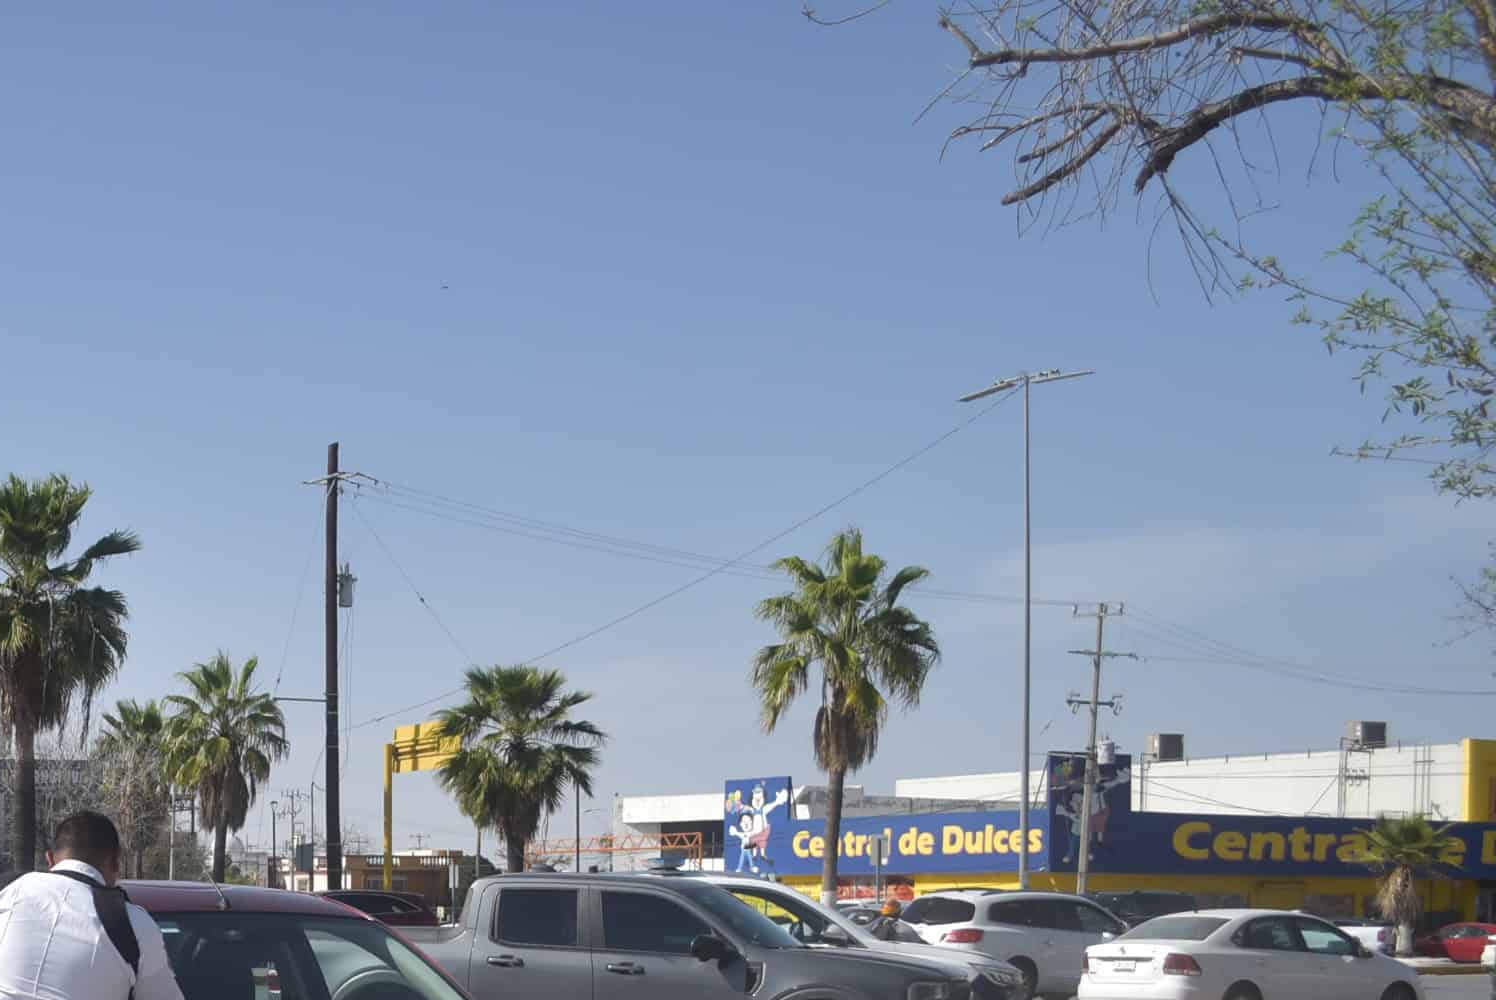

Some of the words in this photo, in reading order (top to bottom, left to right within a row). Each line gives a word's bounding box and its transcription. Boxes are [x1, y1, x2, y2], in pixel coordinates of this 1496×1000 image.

[793, 826, 892, 858] Cetrl
[898, 827, 935, 855] de
[942, 824, 1043, 854] Dulces
[1172, 821, 1370, 864] Centra
